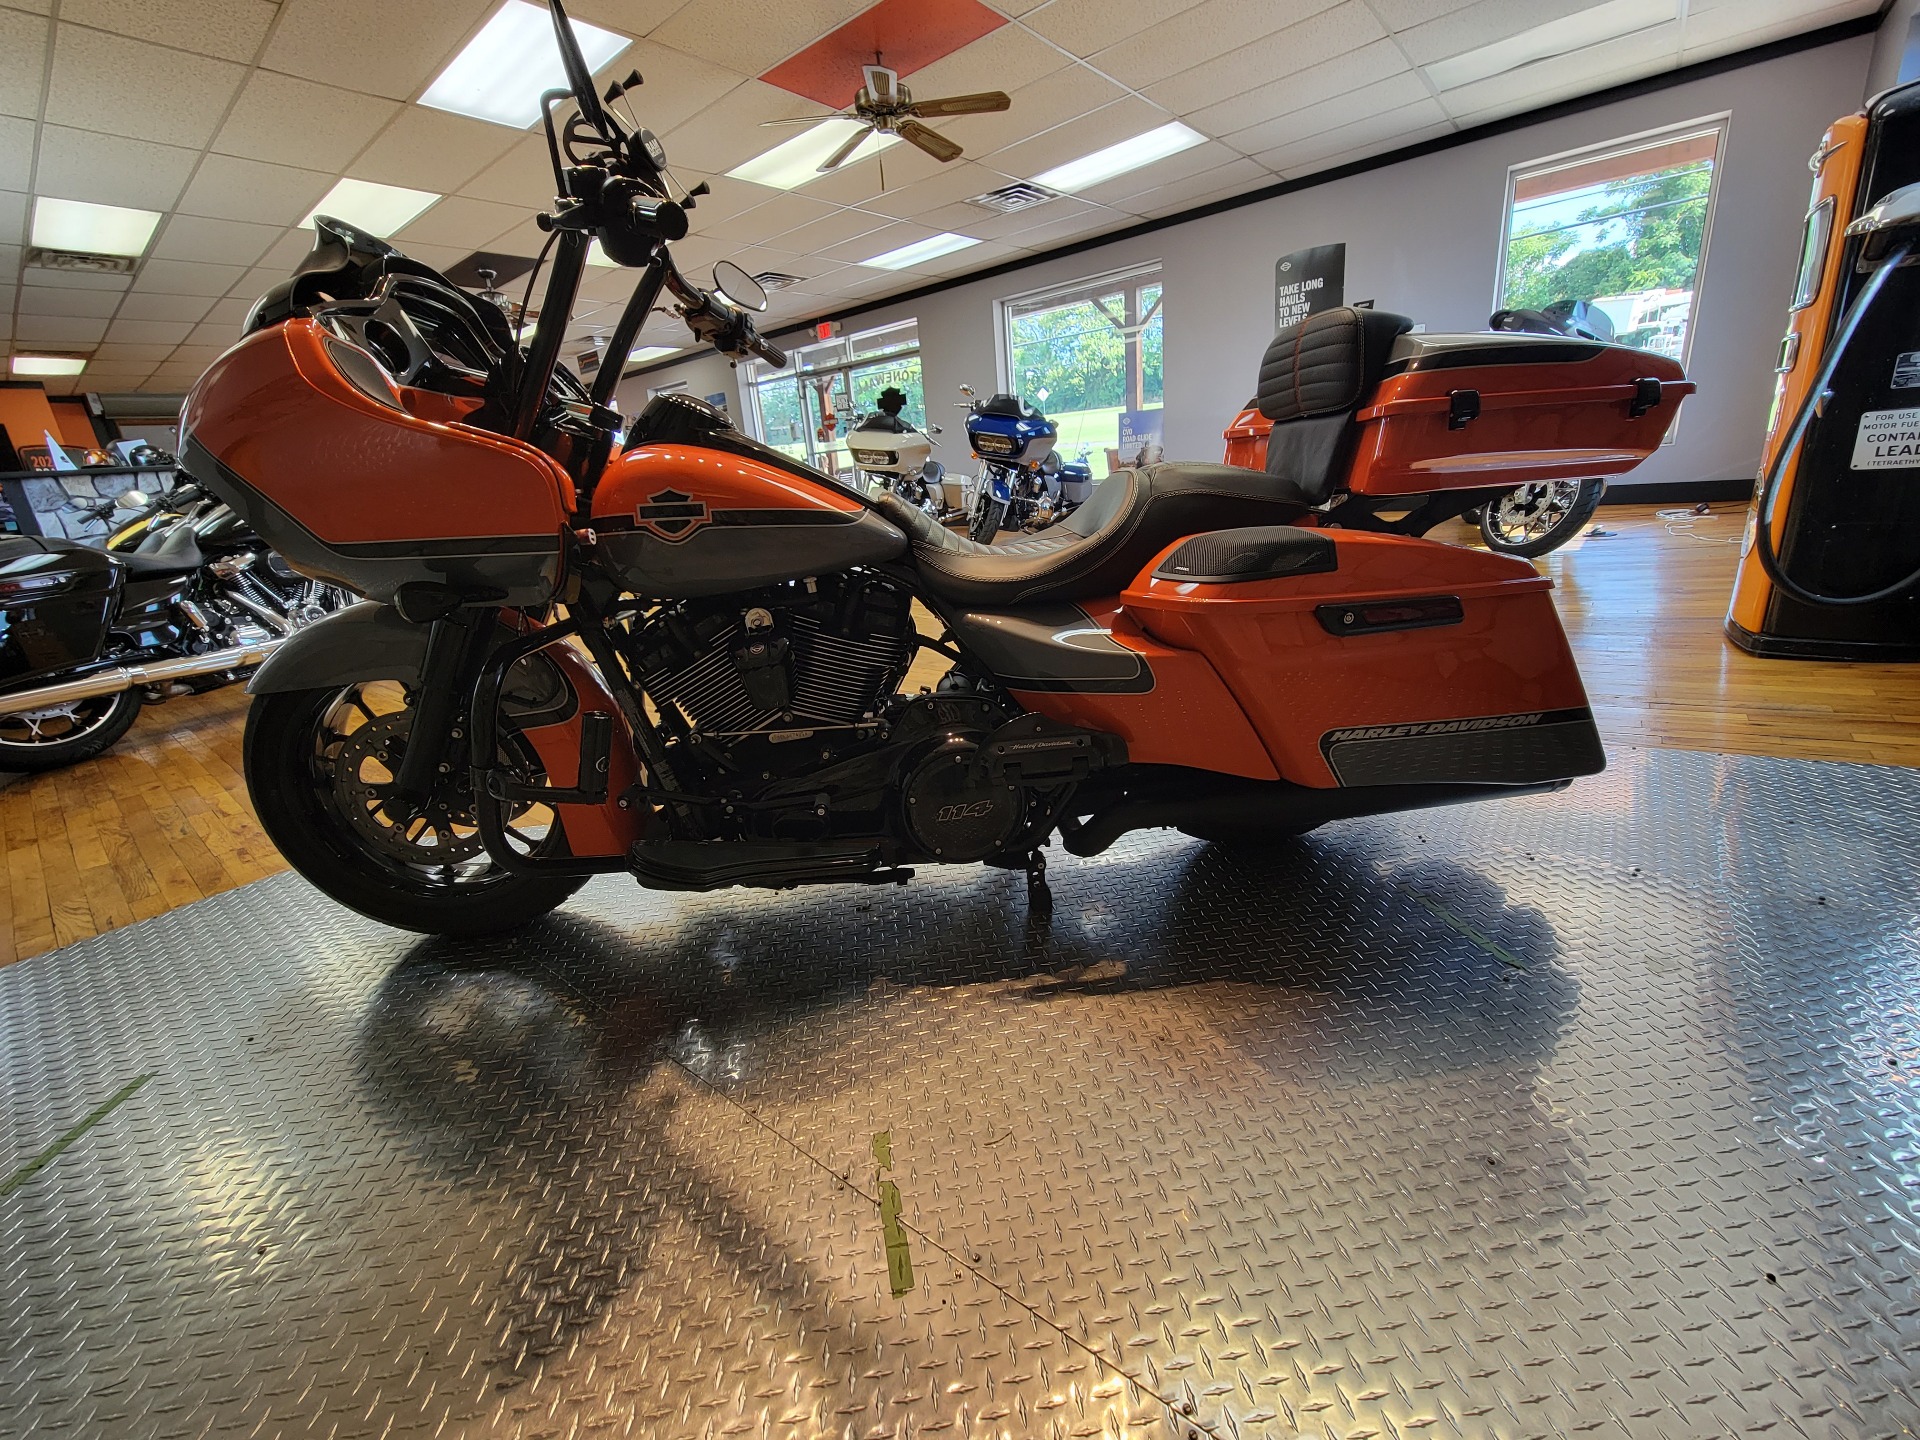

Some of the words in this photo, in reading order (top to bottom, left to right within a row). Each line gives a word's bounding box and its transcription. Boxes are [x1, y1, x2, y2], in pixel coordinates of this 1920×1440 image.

[1280, 283, 1299, 296] TAKE
[1302, 278, 1323, 291] LONG
[1280, 293, 1306, 307] HAULS
[1279, 307, 1289, 317] TO
[1292, 302, 1310, 315] NEW
[1329, 714, 1543, 741] HARLEY-DAVIDSON
[938, 800, 993, 821] 114
